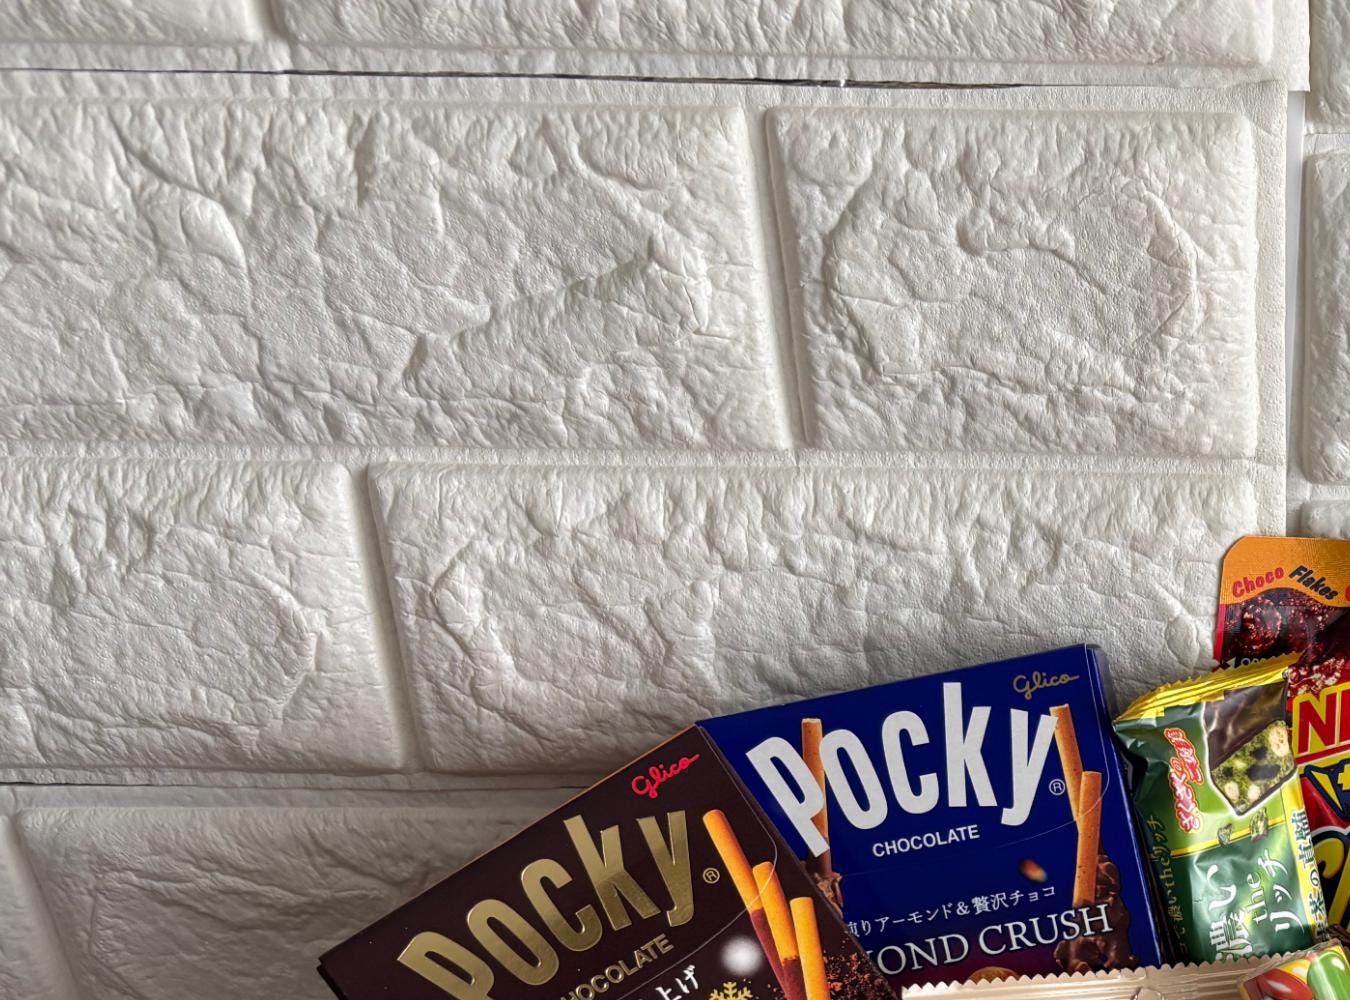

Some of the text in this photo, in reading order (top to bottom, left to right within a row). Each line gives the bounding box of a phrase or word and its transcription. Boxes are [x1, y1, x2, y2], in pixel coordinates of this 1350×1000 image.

[1232, 566, 1284, 597] Choco
[1289, 564, 1338, 600] Flakes
[1013, 672, 1079, 699] Glico
[632, 754, 699, 798] Glico
[746, 682, 1058, 857] Pocky
[872, 825, 980, 857] CHOCOLATE
[1247, 871, 1268, 923] the
[1258, 850, 1305, 933] リッチ
[867, 903, 1113, 976] OND CRUSH
